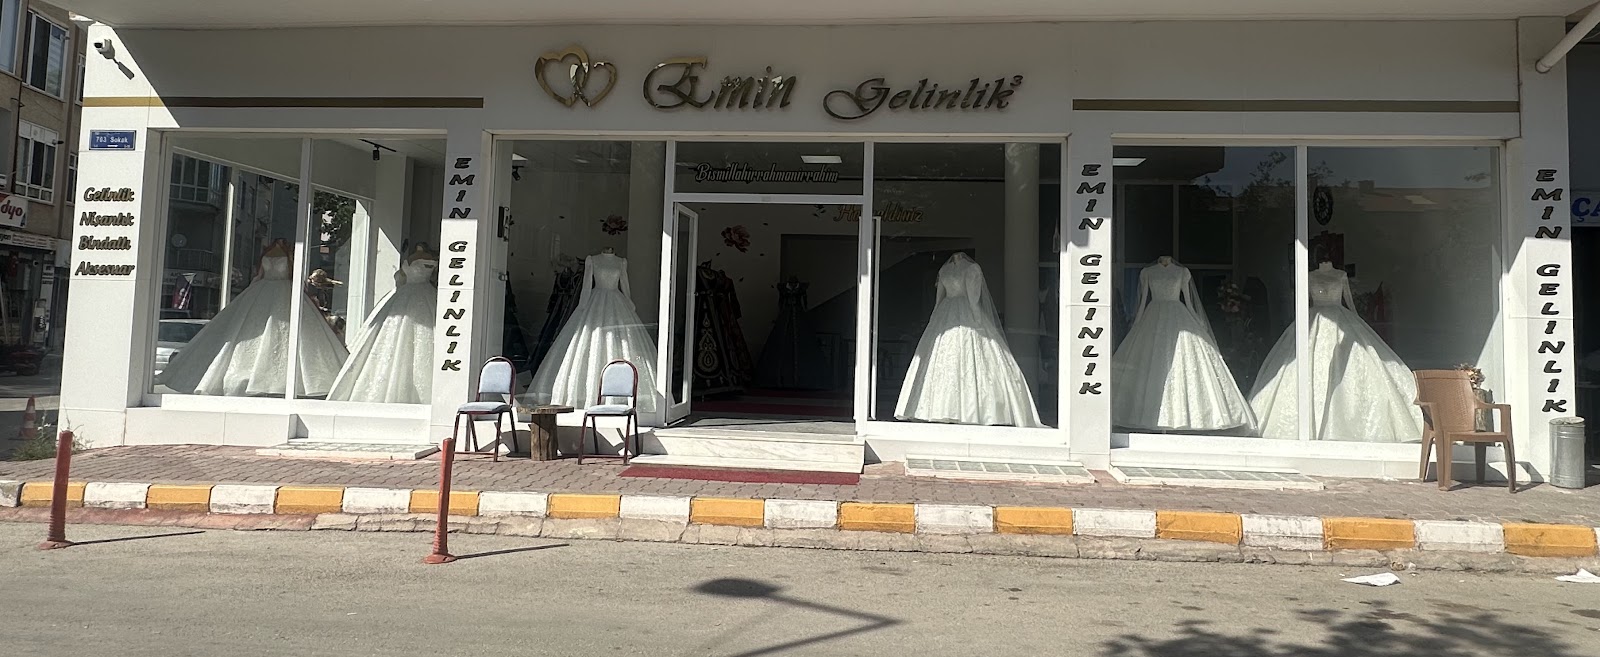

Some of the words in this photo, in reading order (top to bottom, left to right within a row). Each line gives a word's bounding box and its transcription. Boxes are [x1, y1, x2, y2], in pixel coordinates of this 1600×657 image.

[643, 56, 797, 110] Emin
[83, 187, 135, 202] Gelinlik
[74, 260, 136, 276] Aksesuar
